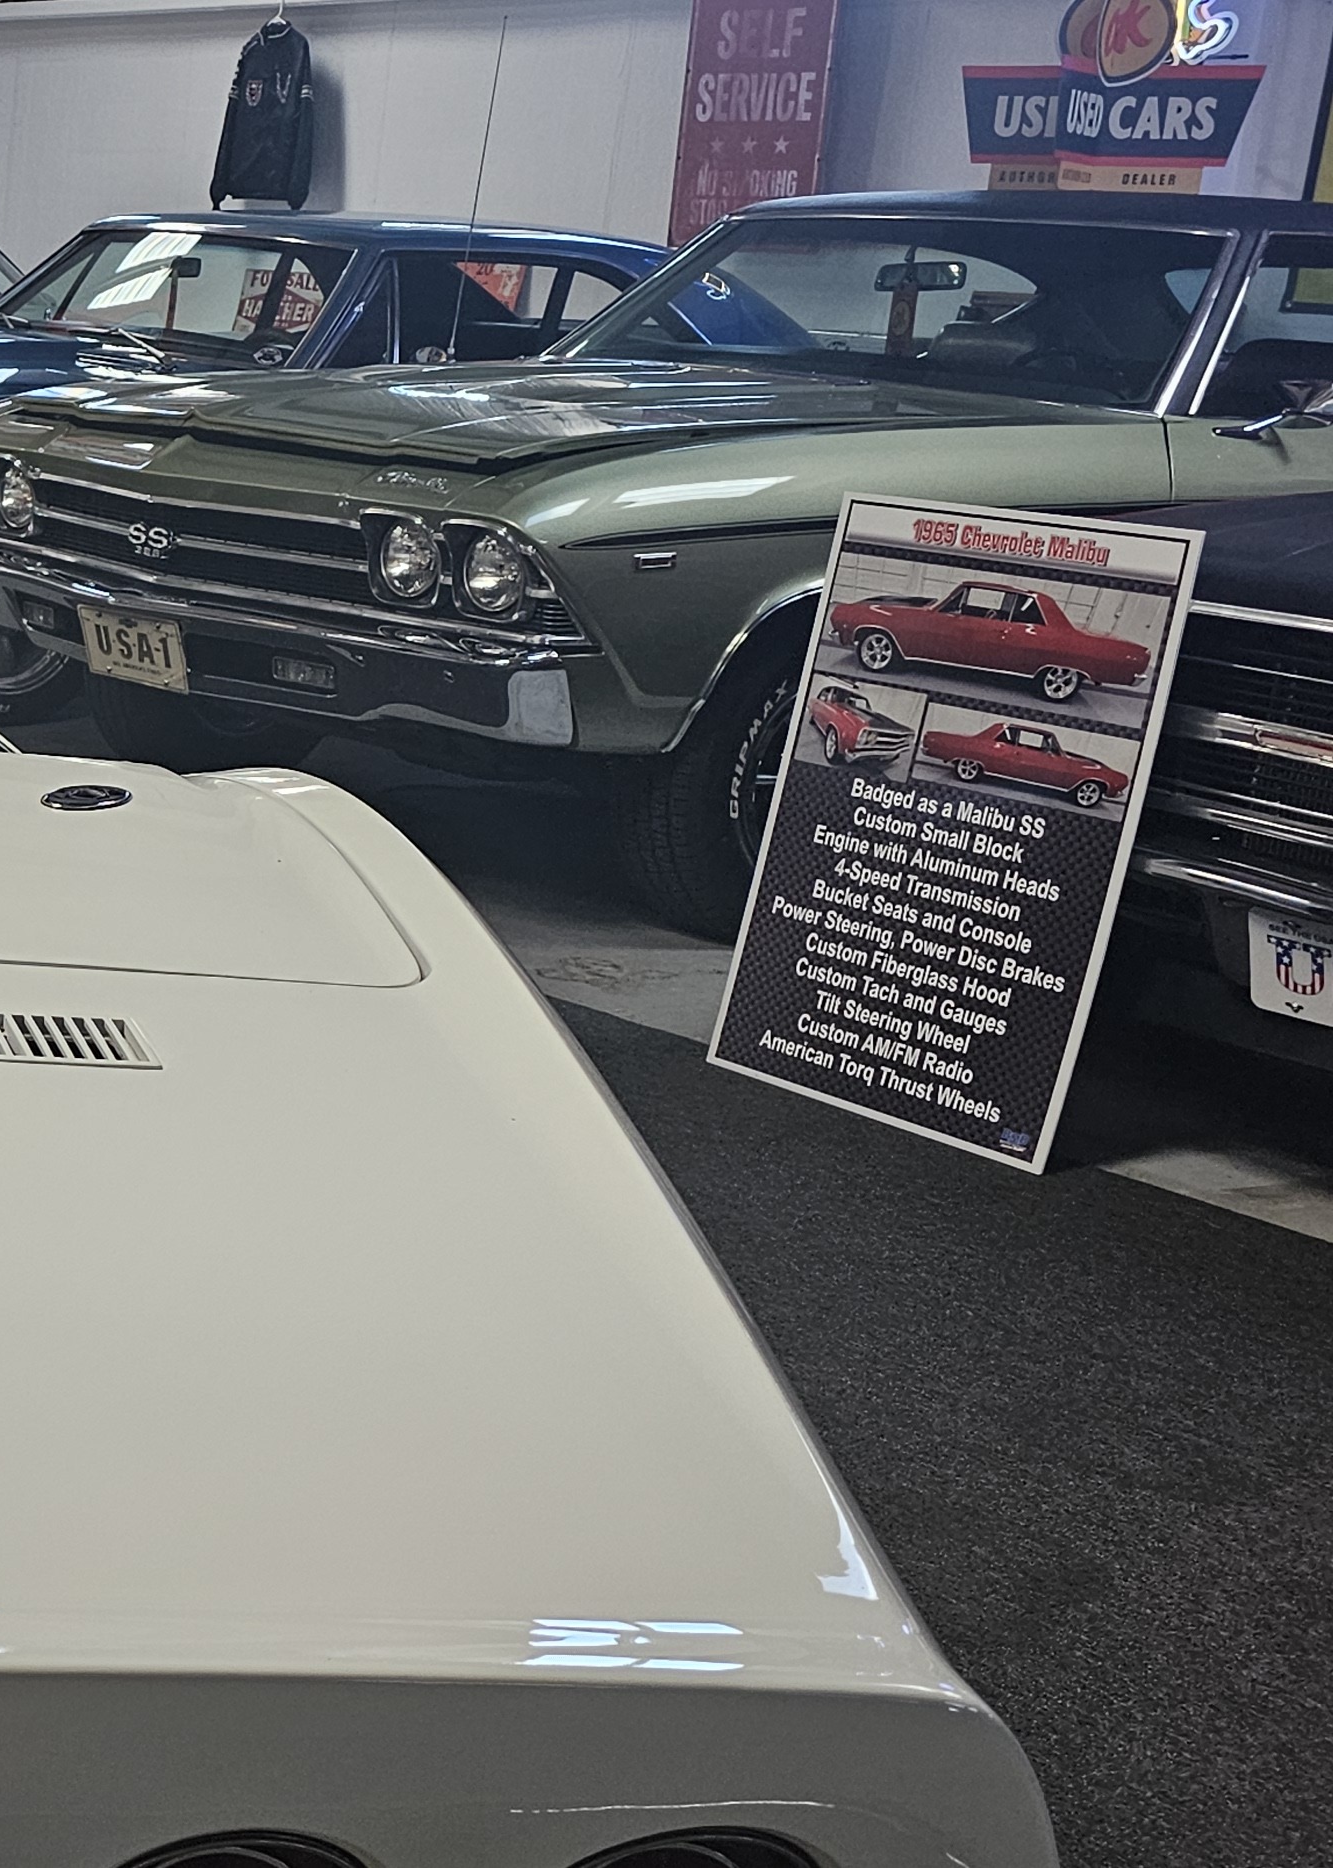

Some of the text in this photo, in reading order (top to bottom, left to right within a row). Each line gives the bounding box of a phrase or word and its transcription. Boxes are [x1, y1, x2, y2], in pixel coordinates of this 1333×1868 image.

[717, 7, 808, 60] SELF
[695, 72, 817, 122] SERVICE
[1108, 96, 1218, 141] CARS
[1121, 173, 1176, 186] DEALER
[127, 523, 169, 549] SS
[913, 518, 1111, 567] 1965 Chevrolet Malibu
[850, 777, 1046, 840] Badged as a Malibu SS
[853, 806, 1025, 864] Custom Small Block
[813, 824, 1061, 902] Engine with Aluminum Heads
[834, 858, 1022, 921] 4-Speed Transmission
[771, 896, 1066, 993] Power Steering, Power Disc Brakes
[812, 878, 1033, 955] Bucket Seats and Console
[795, 957, 1008, 1036] Custom Tach and Gauges
[806, 932, 1012, 1008] Custom Fiberglass Hood
[797, 1013, 975, 1085] Custom AM/FM Radio
[816, 989, 972, 1055] Tilt Steering Wheel
[759, 1029, 1001, 1123] American Torq Thrust Wheels
